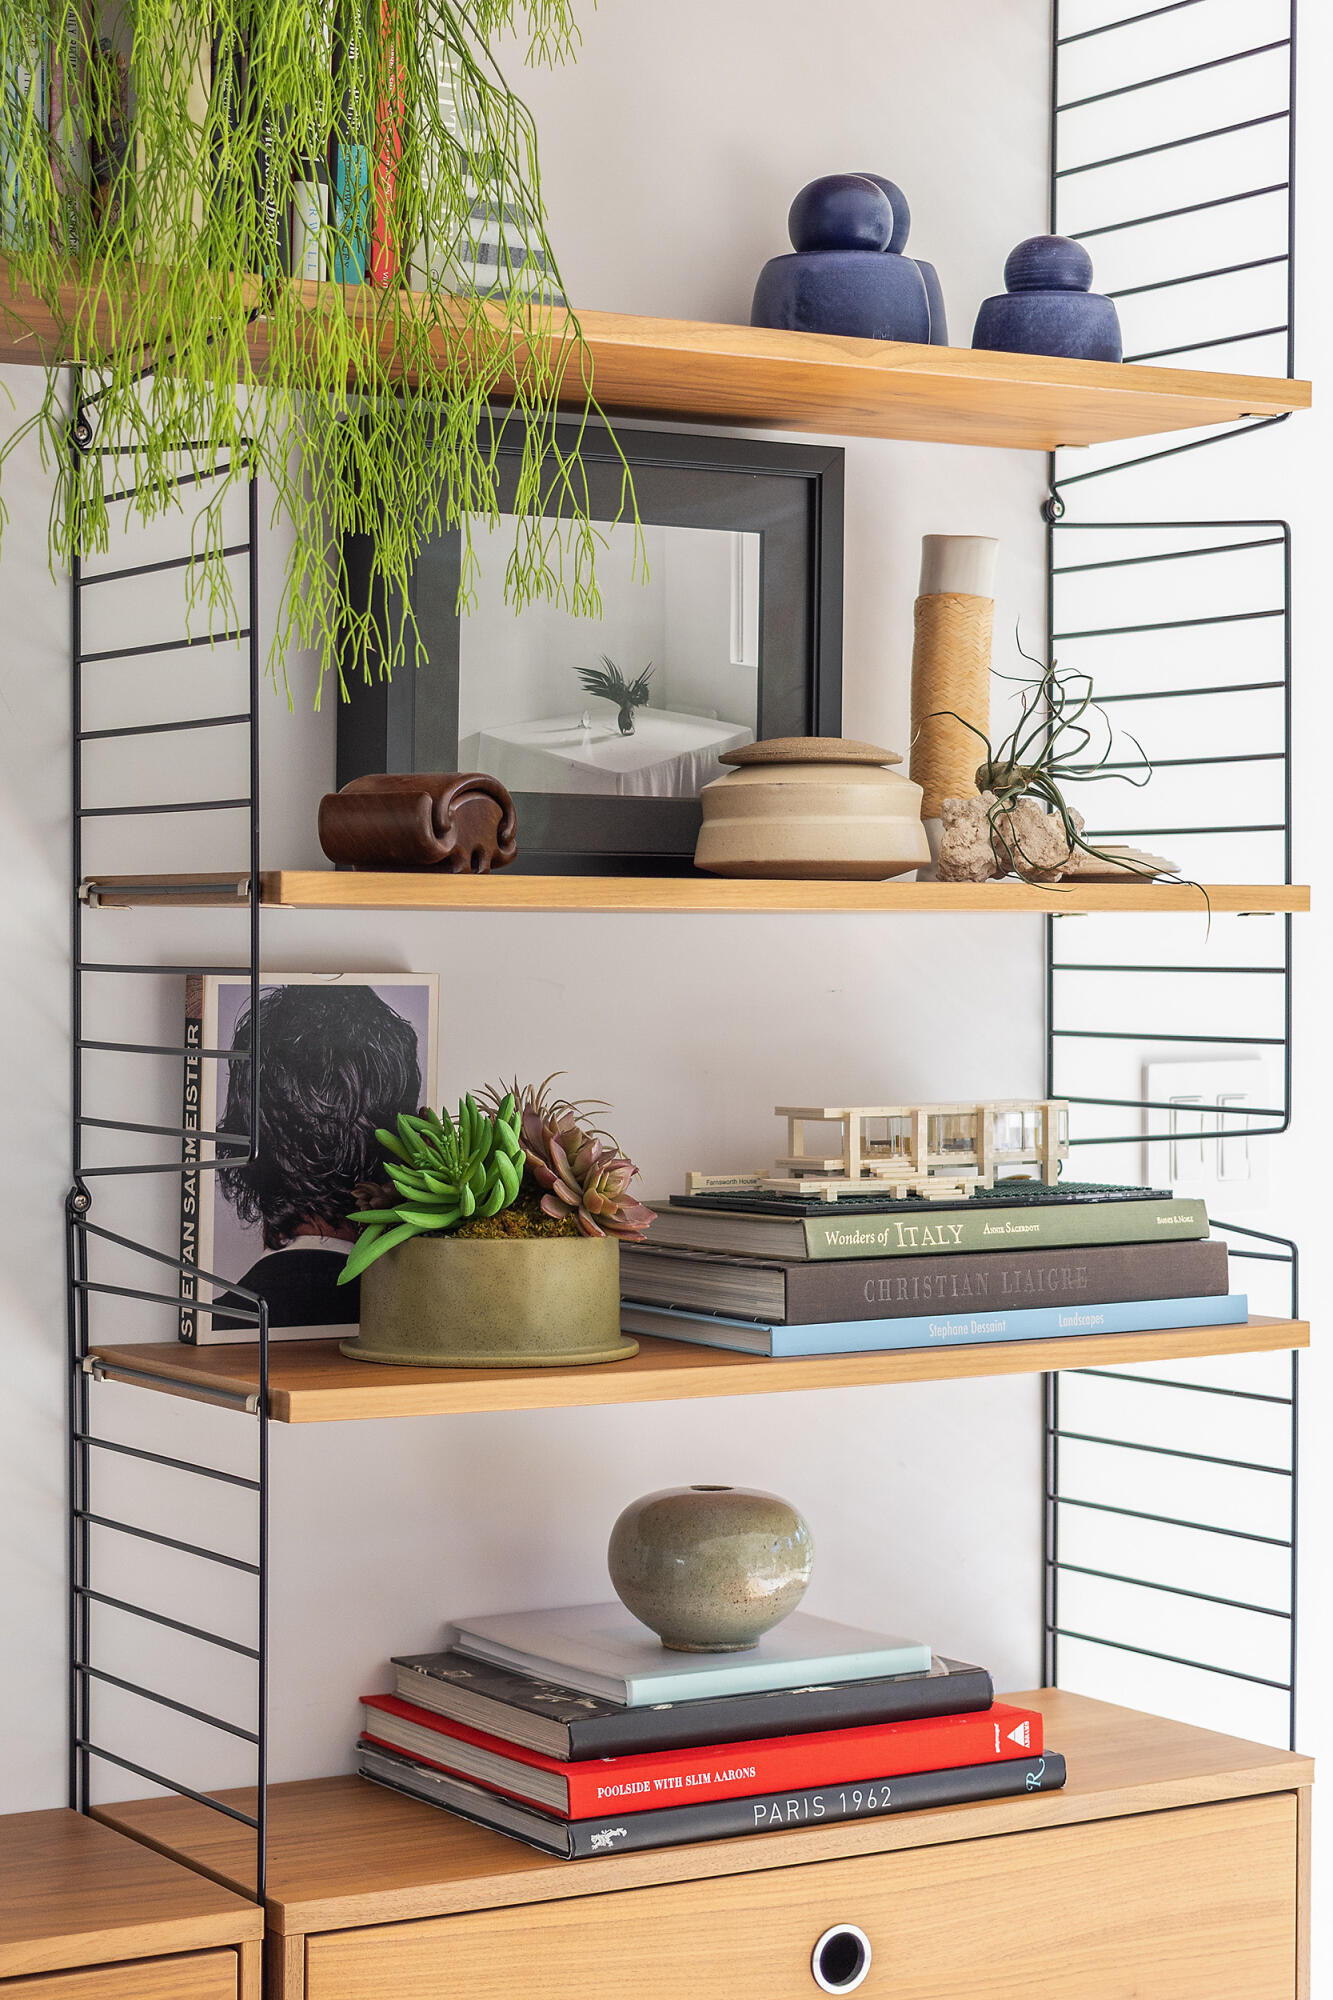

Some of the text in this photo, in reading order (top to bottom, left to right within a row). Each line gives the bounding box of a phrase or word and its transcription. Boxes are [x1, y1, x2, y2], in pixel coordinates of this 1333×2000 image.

[183, 1024, 199, 1215] SAGMEISTER
[825, 1230, 876, 1246] Wonders
[878, 1228, 889, 1247] of
[894, 1222, 964, 1247] ITALY
[864, 1267, 1088, 1303] CHRISTIAN LIAIGRE
[929, 1312, 1104, 1339] Stephane Dessaint Landscapes
[597, 1766, 756, 1799] POOLSIDE WITH SLIM AARONS
[753, 1786, 891, 1826] PARIS 1962
